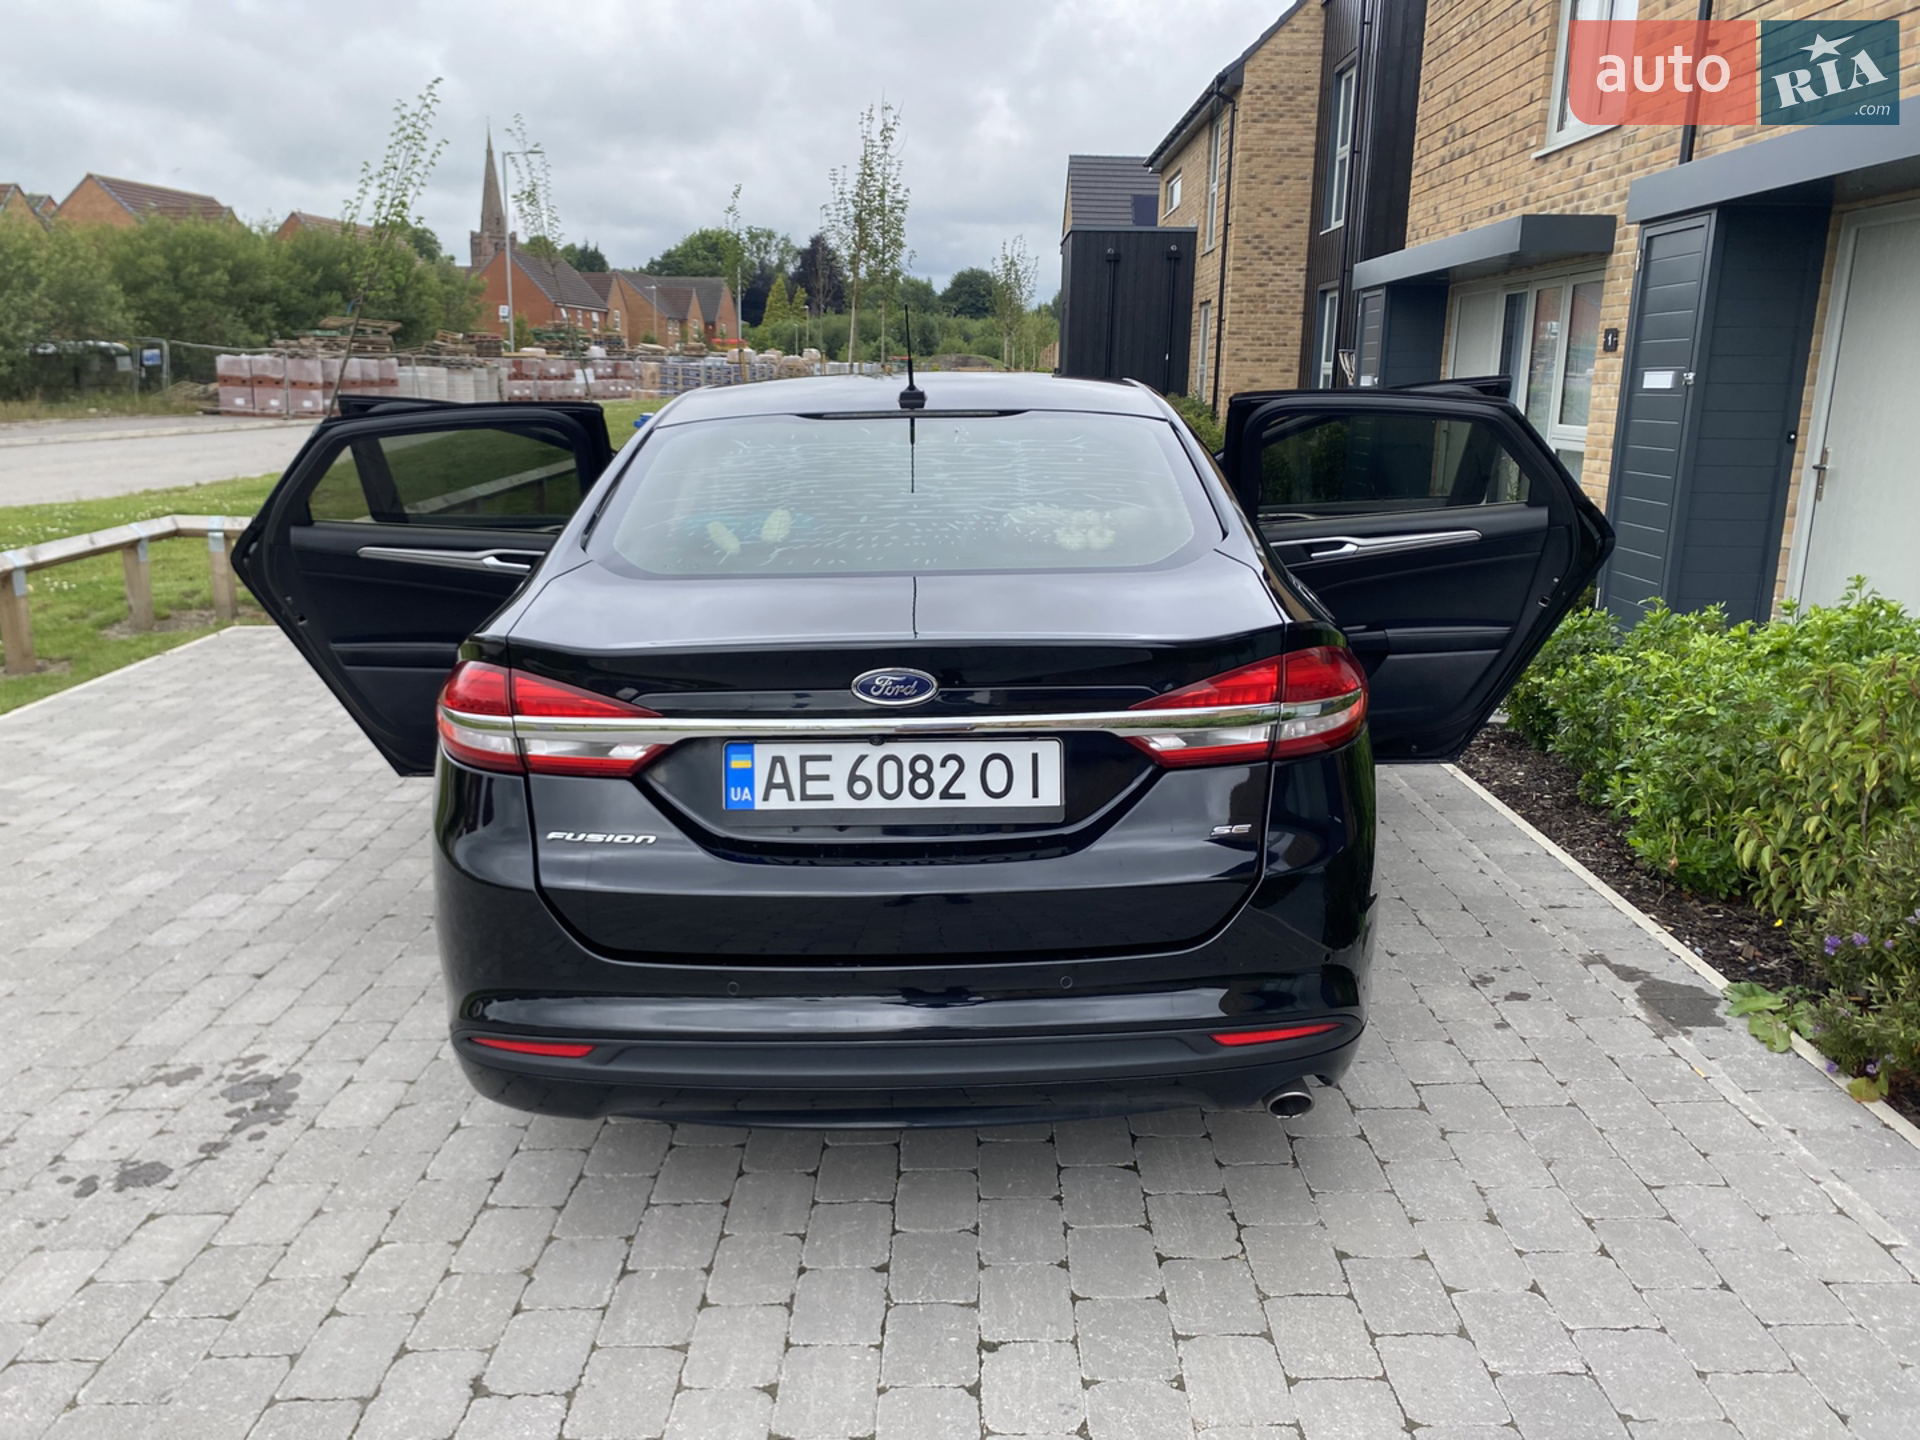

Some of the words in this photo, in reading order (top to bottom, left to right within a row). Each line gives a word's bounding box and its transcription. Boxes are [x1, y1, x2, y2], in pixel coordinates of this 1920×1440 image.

[870, 675, 918, 696] Ford
[762, 754, 834, 802] AE
[847, 753, 966, 801] 6082
[731, 787, 752, 802] UA
[1210, 823, 1252, 836] SE
[546, 831, 657, 844] FUSION
